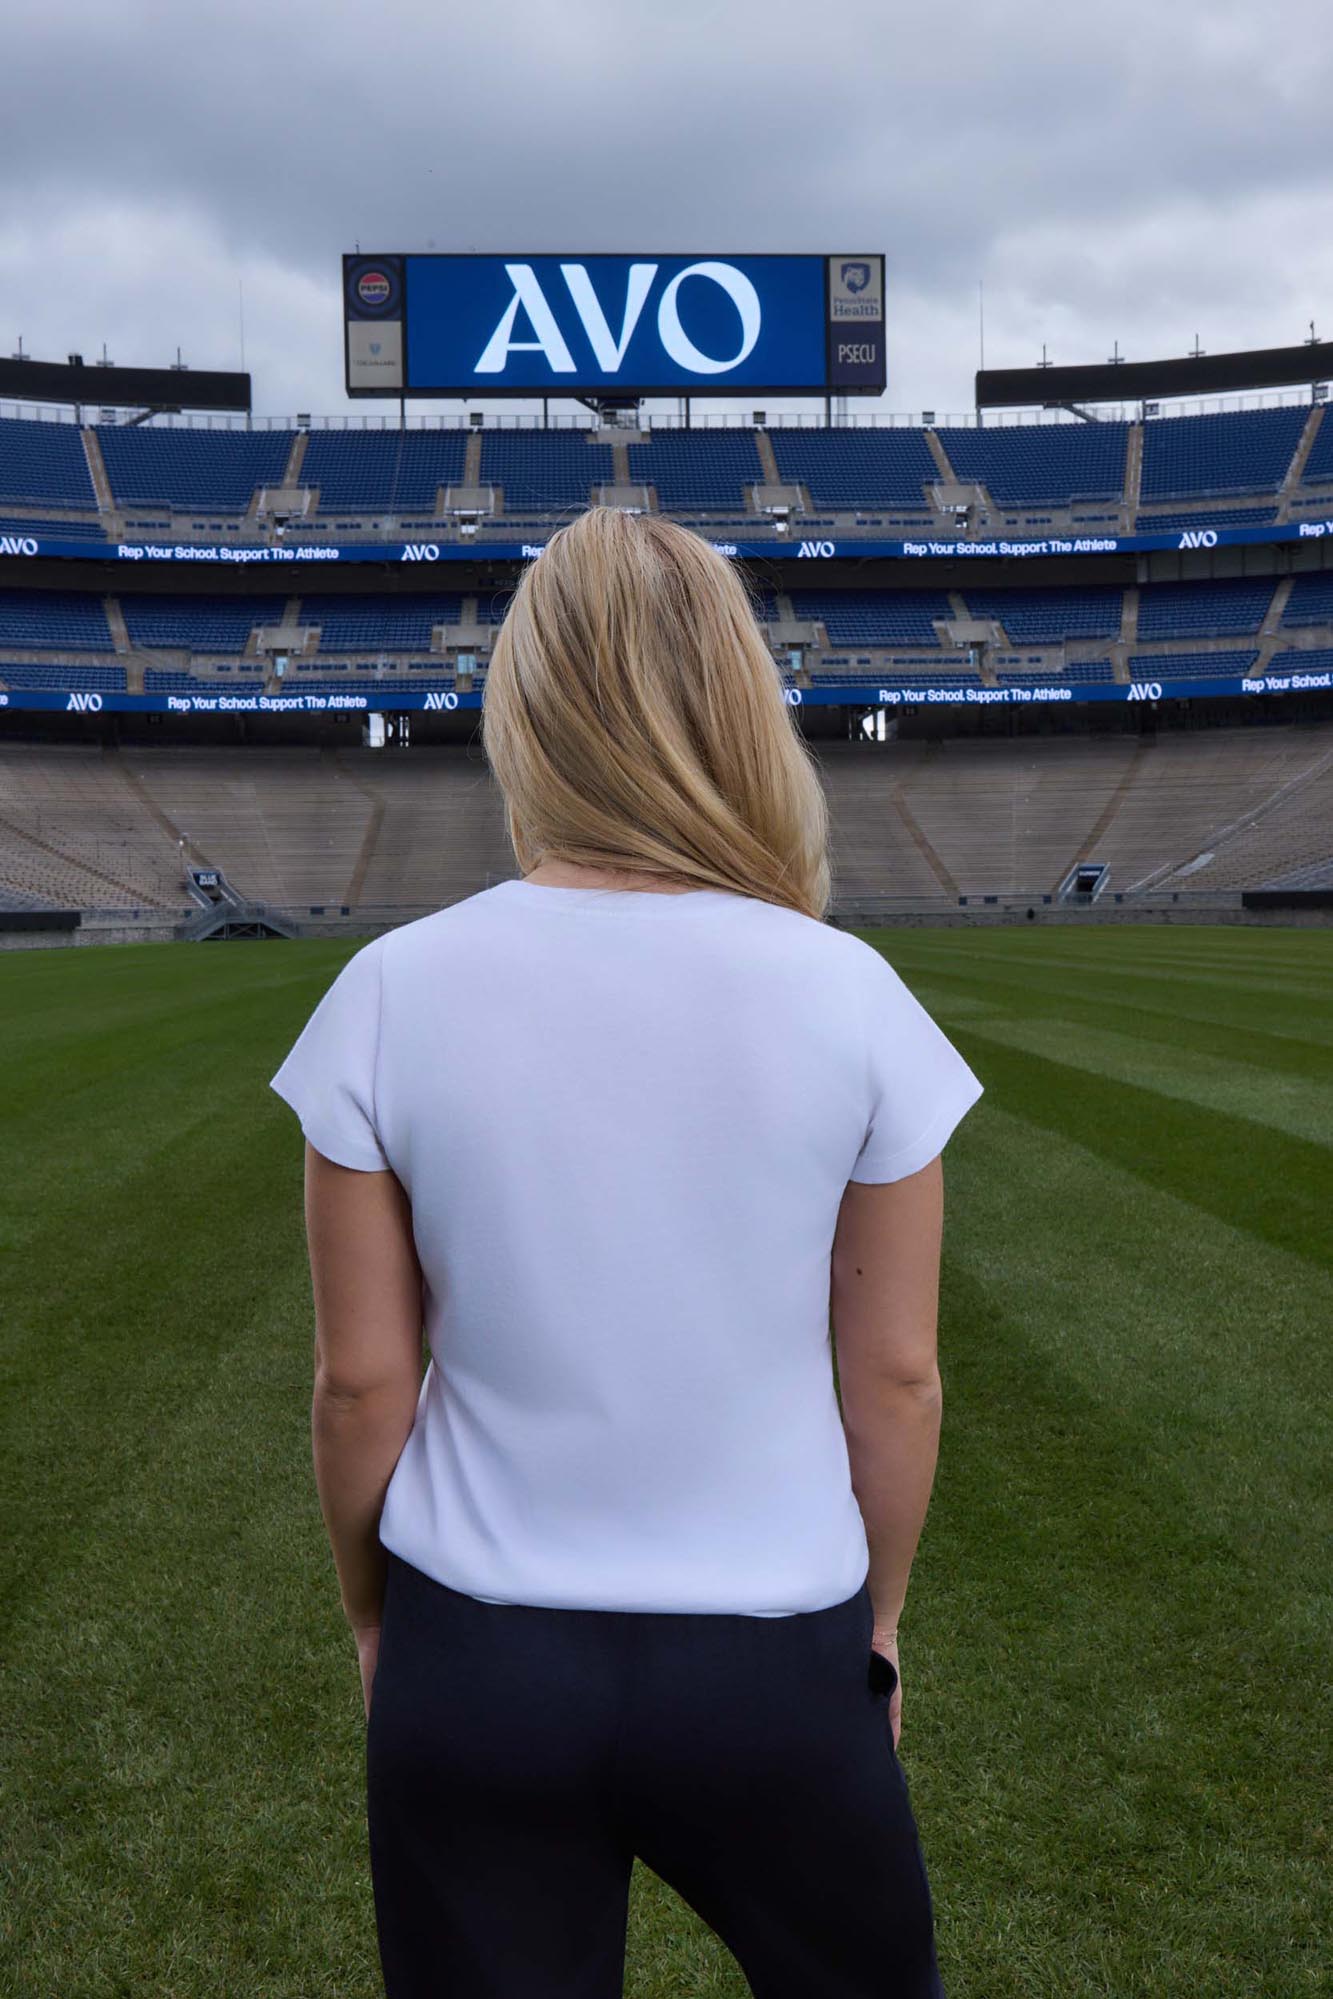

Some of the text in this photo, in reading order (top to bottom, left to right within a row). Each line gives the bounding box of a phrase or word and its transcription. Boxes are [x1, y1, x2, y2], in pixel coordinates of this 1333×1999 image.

[360, 284, 387, 292] PEPSI
[473, 261, 761, 374] AVO
[834, 304, 879, 316] Health
[838, 344, 876, 363] PSECU
[1178, 529, 1218, 549] AVO
[1299, 523, 1325, 538] Rep
[0, 536, 39, 556] AVO
[118, 545, 144, 560] Rep
[144, 546, 173, 558] Your
[219, 547, 269, 562] Support
[270, 547, 294, 560] The
[295, 546, 339, 560] Athlete
[401, 544, 440, 561] AVO
[797, 541, 835, 558] AVO
[903, 542, 928, 557] Rep
[928, 542, 955, 554] Your
[999, 541, 1047, 556] Support
[1048, 540, 1073, 552] The
[1073, 539, 1118, 552] Athlete
[1127, 682, 1163, 701] AVO
[1242, 678, 1265, 693] Rep
[1265, 676, 1291, 690] Your
[66, 693, 103, 711] AVO
[167, 696, 191, 712] Rep
[191, 697, 218, 709] Your
[259, 696, 304, 711] Support
[304, 695, 327, 709] The
[327, 695, 368, 709] Athlete
[423, 692, 459, 710] AVO
[879, 689, 901, 704] Rep
[901, 689, 927, 702] Your
[965, 688, 1009, 704] Support
[1010, 688, 1032, 701] The
[1032, 687, 1072, 701] Athlete
